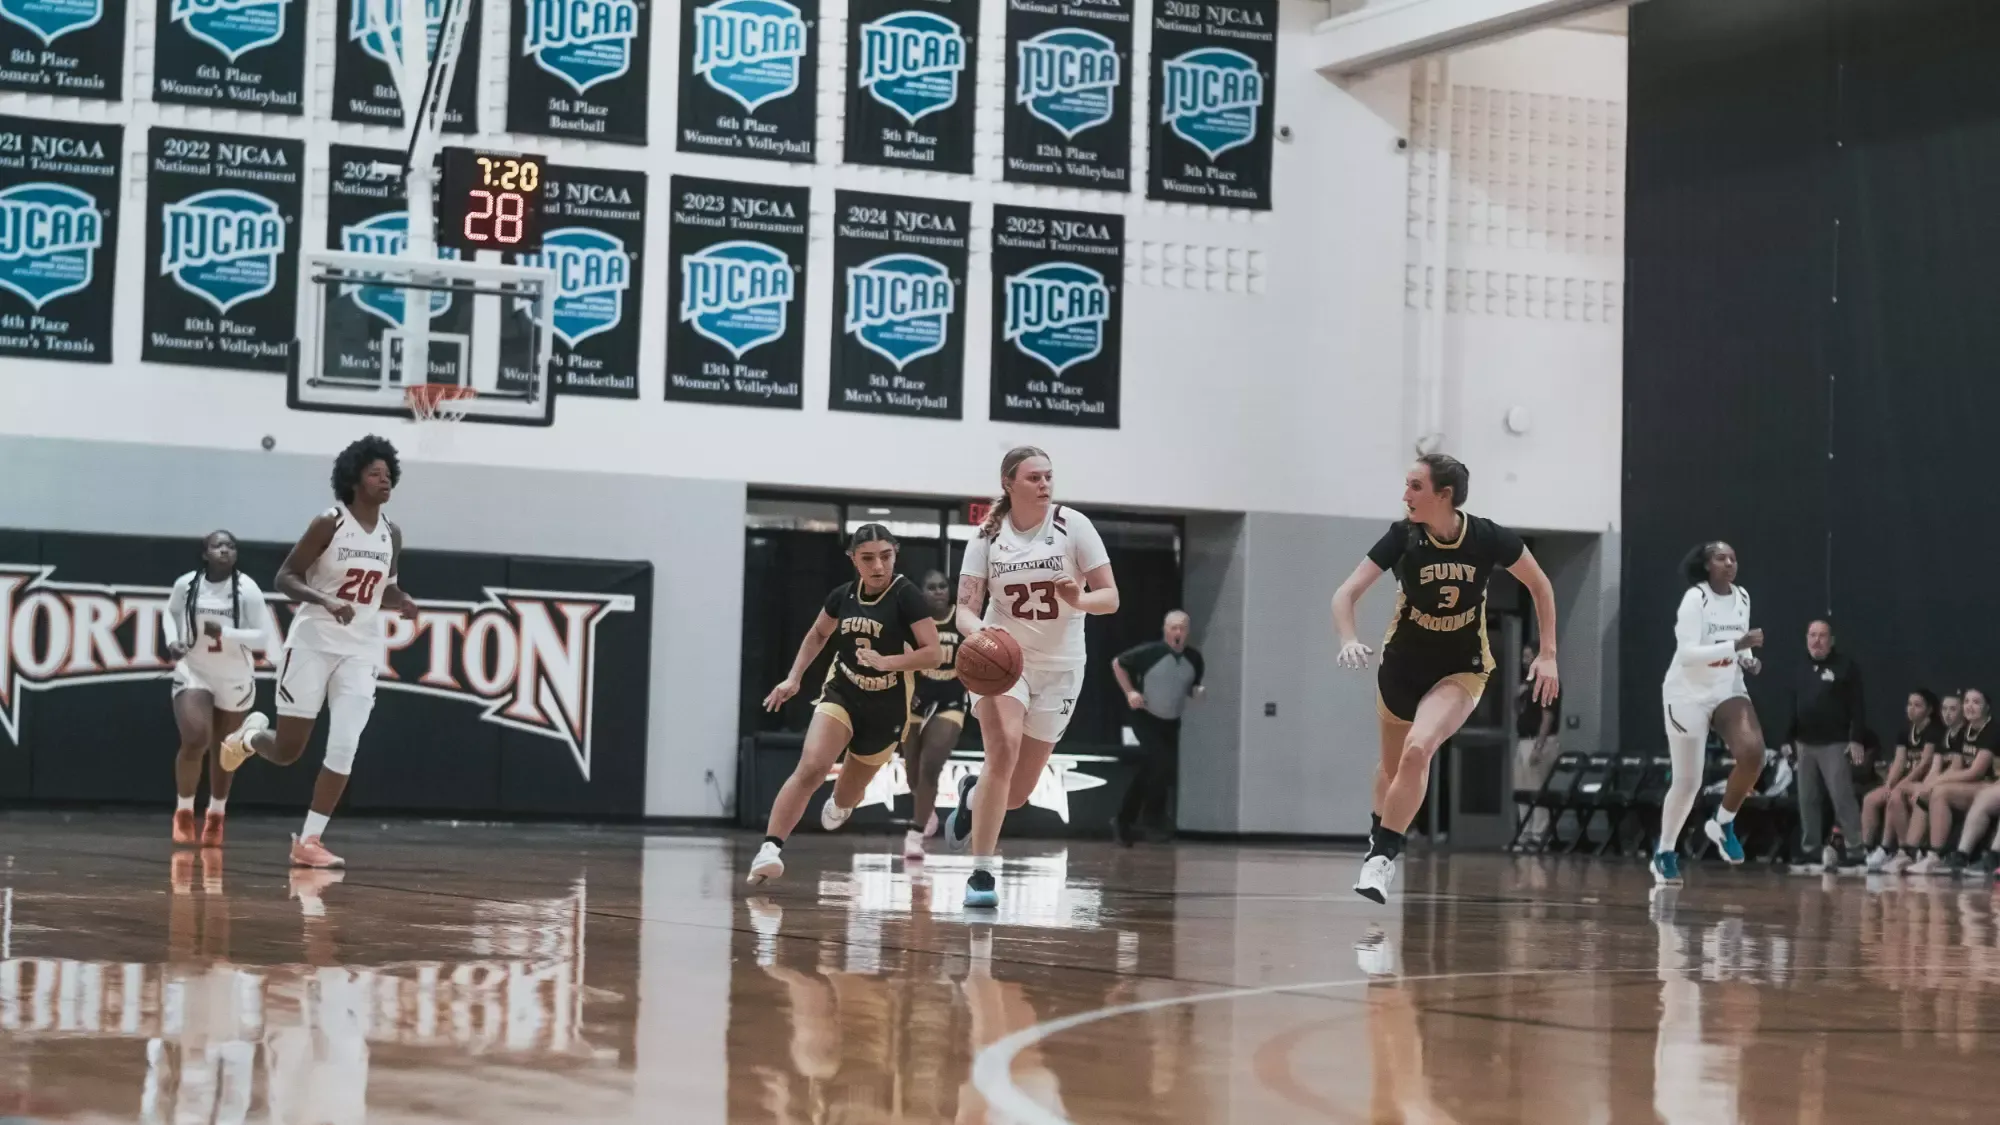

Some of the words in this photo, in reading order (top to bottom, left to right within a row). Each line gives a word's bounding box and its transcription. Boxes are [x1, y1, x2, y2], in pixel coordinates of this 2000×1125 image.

[1010, 0, 1058, 14] National
[1061, 4, 1130, 22] Tournament
[1164, 1, 1200, 19] 2018
[1206, 5, 1265, 26] NJCAA
[699, 13, 802, 64] NJCAA
[1155, 18, 1202, 34] National
[1206, 22, 1273, 41] Tournament
[11, 48, 35, 64] 8th
[41, 51, 79, 69] Place
[865, 28, 961, 79] NJCAA
[0, 64, 51, 84] omen's
[55, 70, 105, 89] Tennis
[196, 65, 220, 81] 6th
[225, 66, 262, 84] Place
[1022, 46, 1114, 95] NJCAA
[160, 79, 223, 99] Women's
[229, 88, 297, 108] Volleyball
[1166, 64, 1260, 115] NJCAA
[573, 100, 608, 116] Place
[549, 115, 605, 133] Baseball
[716, 117, 739, 131] 6th
[744, 118, 778, 134] Place
[31, 135, 105, 159] NJCAA
[684, 129, 742, 148] Women's
[748, 136, 810, 155] Volleyball
[905, 130, 938, 145] Place
[165, 138, 210, 160] 2022
[217, 143, 288, 167] NJCAA
[883, 144, 935, 161] Baseball
[1066, 146, 1097, 161] Place
[30, 155, 115, 176] Tournament
[154, 158, 211, 175] National
[215, 163, 296, 183] Tournament
[476, 157, 540, 191] 7:20
[1009, 158, 1062, 175] Women's
[1067, 163, 1125, 182] Volleyball
[1206, 166, 1237, 181] Place
[333, 180, 389, 198] National
[567, 183, 632, 205] NJCAA
[1161, 178, 1216, 196] Women's
[1218, 183, 1258, 199] Tennis
[464, 190, 524, 243] 28
[564, 202, 641, 220] Tournament
[731, 196, 796, 218] NJCAA
[675, 211, 726, 228] National
[730, 217, 804, 234] Tournament
[848, 206, 888, 225] 2024
[895, 210, 957, 231] NJCAA
[168, 209, 280, 266] NJCAA
[839, 224, 889, 241] National
[893, 230, 964, 248] Tournament
[1051, 219, 1111, 241] NJCAA
[997, 234, 1046, 250] National
[1050, 239, 1119, 256] Tournament
[686, 260, 789, 314] NJCAA
[851, 272, 950, 325] NJCAA
[1009, 280, 1107, 332] NJCAA
[30, 315, 70, 333] Place
[219, 319, 256, 335] Place
[0, 333, 40, 350] men's
[44, 335, 95, 353] Tennis
[151, 332, 214, 350] Women's
[220, 337, 288, 358] Volleyball
[566, 354, 603, 369] Place
[734, 364, 768, 380] Place
[565, 371, 635, 389] Basketball
[671, 374, 730, 391] Women's
[734, 380, 798, 398] Volleyball
[892, 375, 926, 391] Place
[1051, 381, 1083, 396] Place
[845, 388, 882, 404] Men's
[886, 391, 948, 410] Volleyball
[1005, 394, 1041, 410] Men's
[1046, 398, 1105, 416] Volleyball
[991, 555, 1066, 578] NORTHAMPTON
[1419, 562, 1477, 585] SUNY
[336, 568, 383, 605] 20
[1437, 585, 1460, 609] 3
[1004, 580, 1059, 621] 23
[841, 616, 884, 638] SUNY
